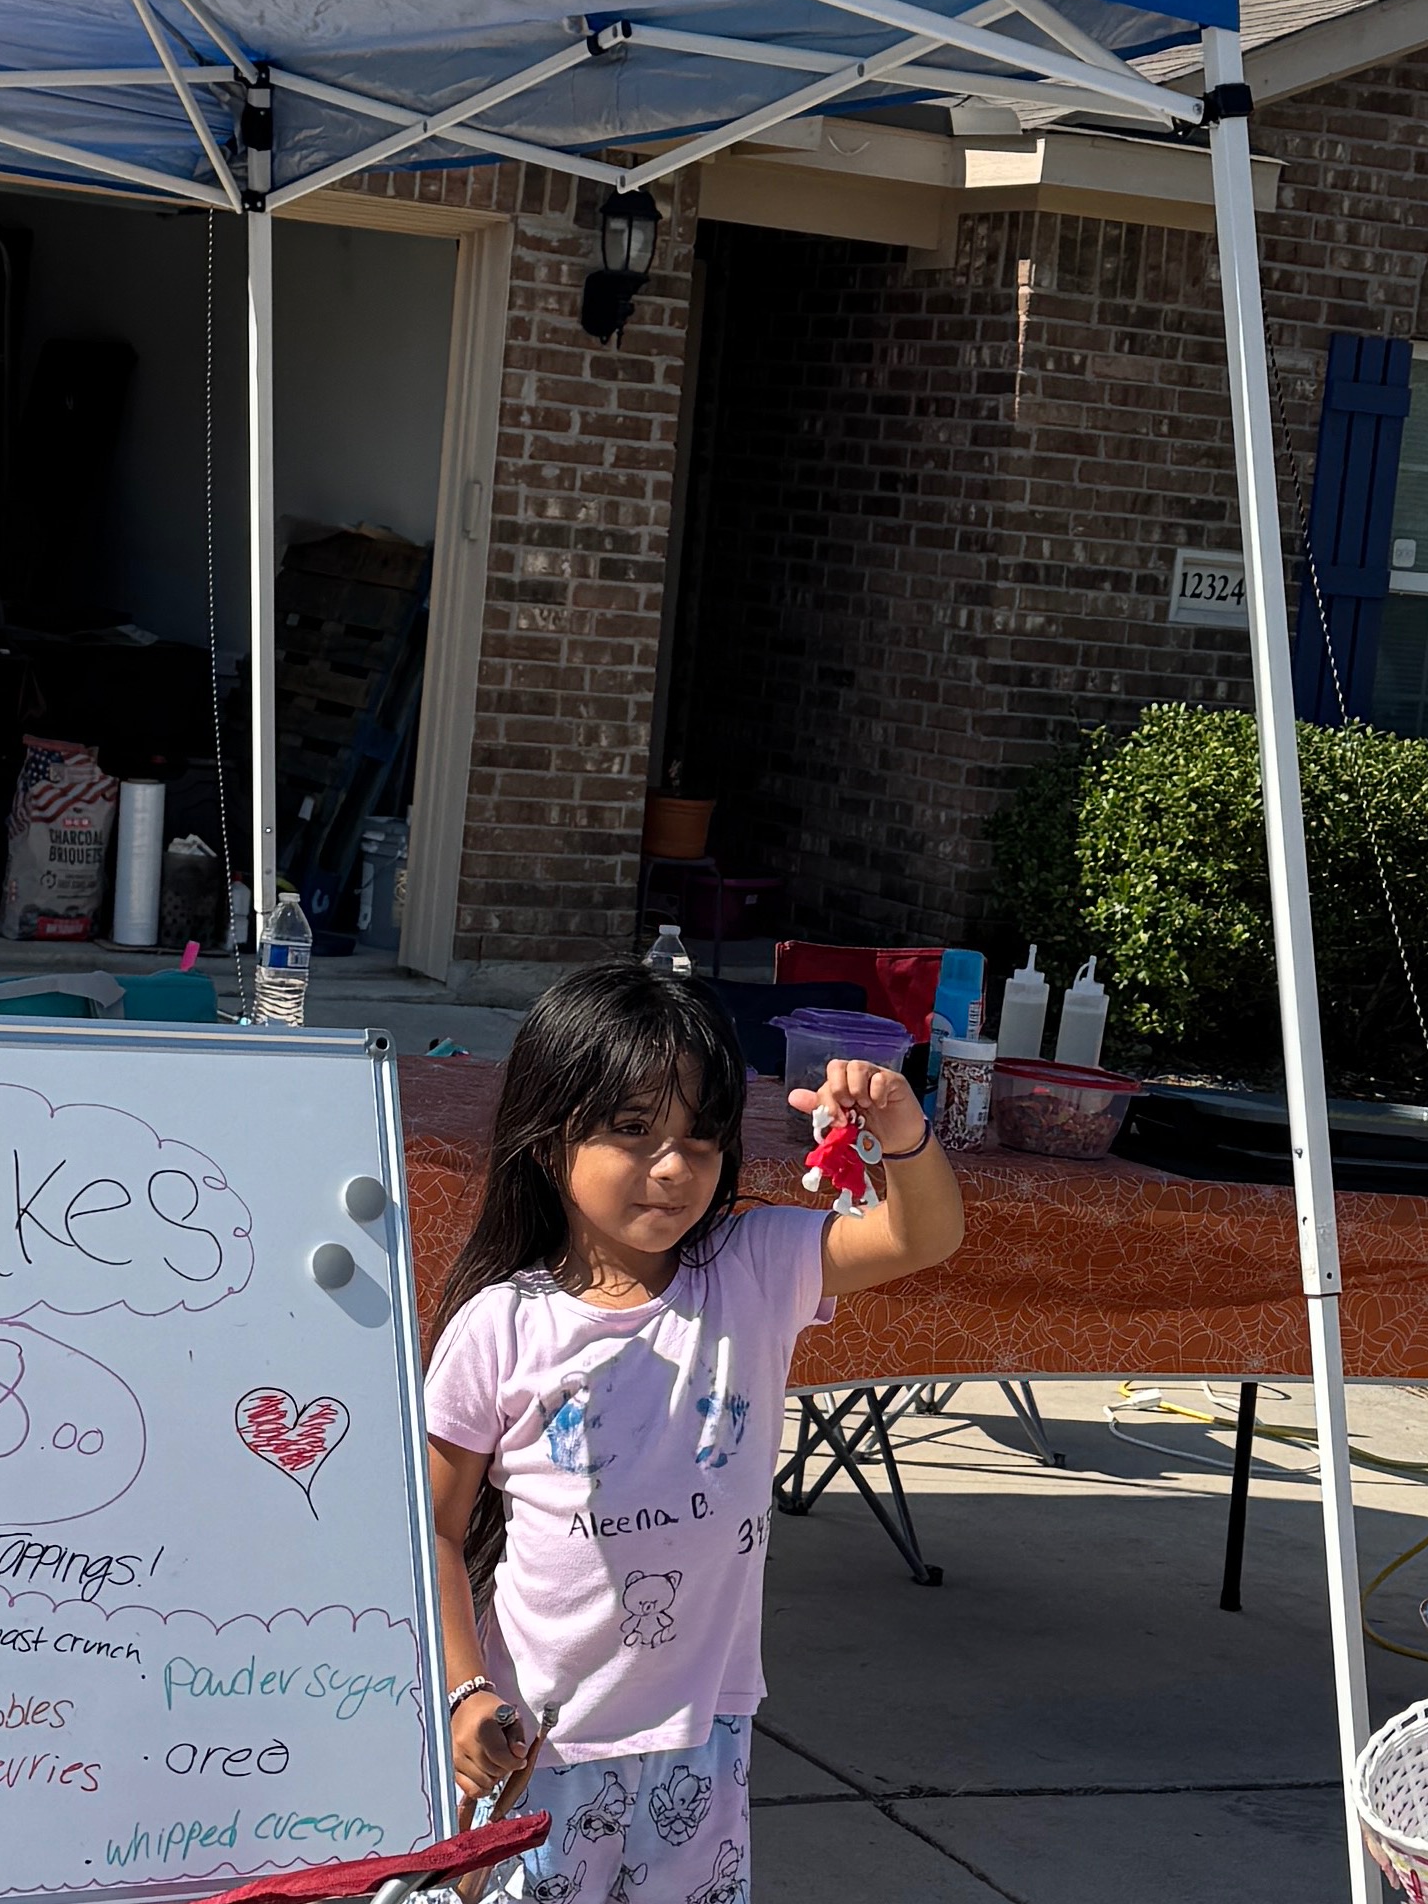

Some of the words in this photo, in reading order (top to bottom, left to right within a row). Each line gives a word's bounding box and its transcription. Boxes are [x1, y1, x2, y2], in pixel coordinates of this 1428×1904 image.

[1179, 571, 1246, 605] 12324
[49, 829, 103, 846] CHARCOAL
[49, 845, 103, 865] BRIQUETS
[569, 1508, 679, 1538] Aleena
[692, 1492, 714, 1519] B.
[53, 1632, 142, 1665] crunch
[106, 1809, 241, 1866] whipped
[255, 1812, 384, 1846] cream
